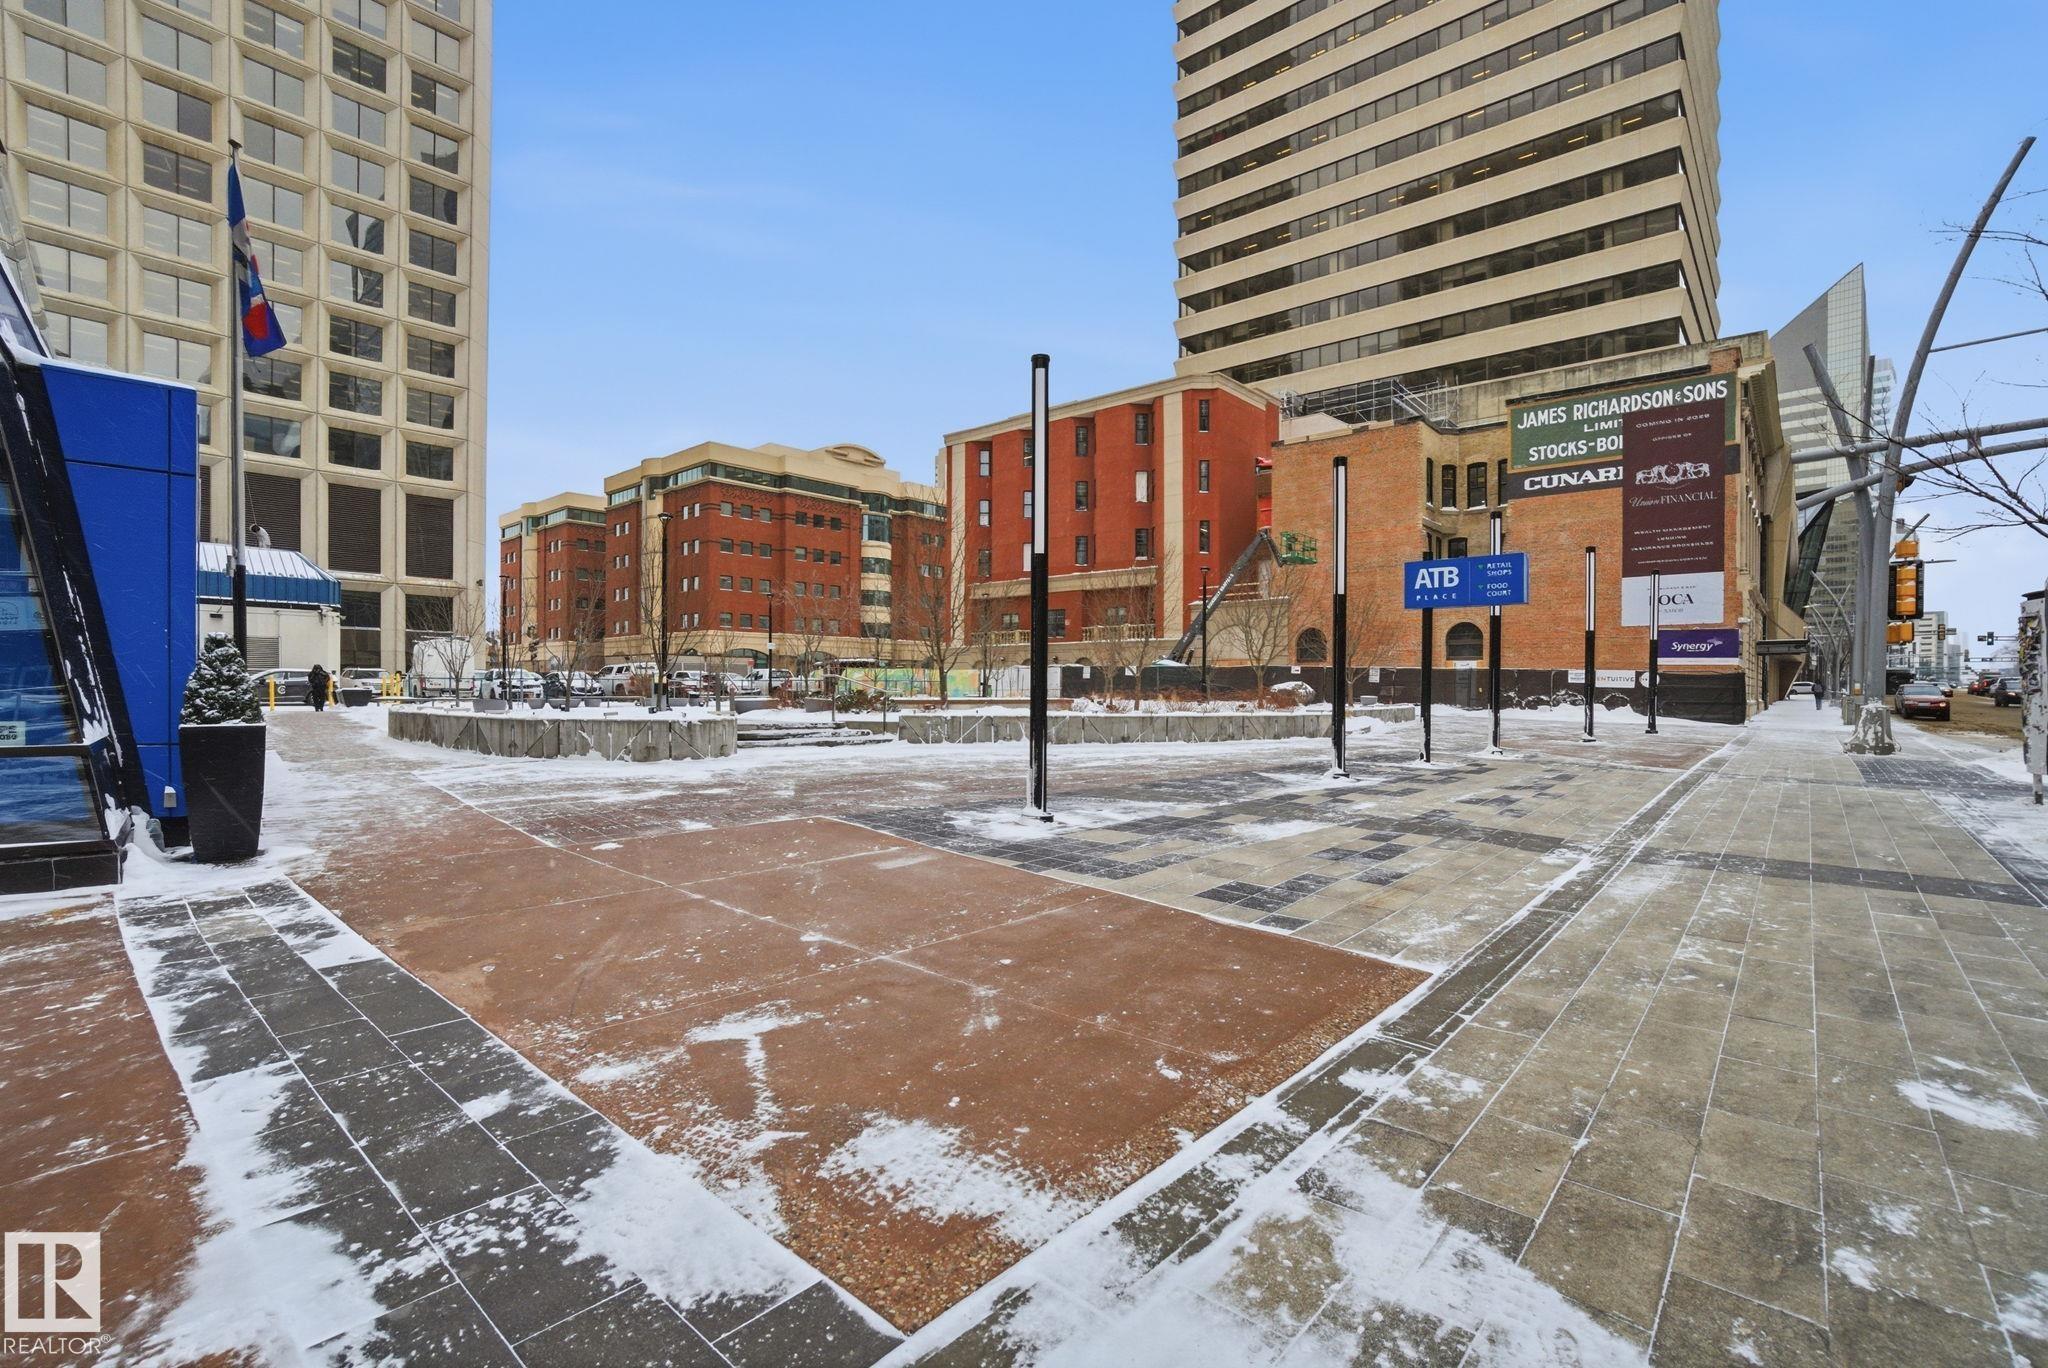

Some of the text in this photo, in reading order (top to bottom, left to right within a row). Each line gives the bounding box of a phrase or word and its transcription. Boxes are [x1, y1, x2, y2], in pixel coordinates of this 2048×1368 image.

[1517, 380, 1728, 429] JAMES RICHARDSON & SONS
[1486, 569, 1512, 577] SHOPS
[1414, 566, 1460, 590] ATB
[1486, 582, 1509, 590] FOOD
[1416, 592, 1457, 601] PLACE
[1486, 589, 1512, 597] COURT
[1671, 640, 1713, 652] Synergy
